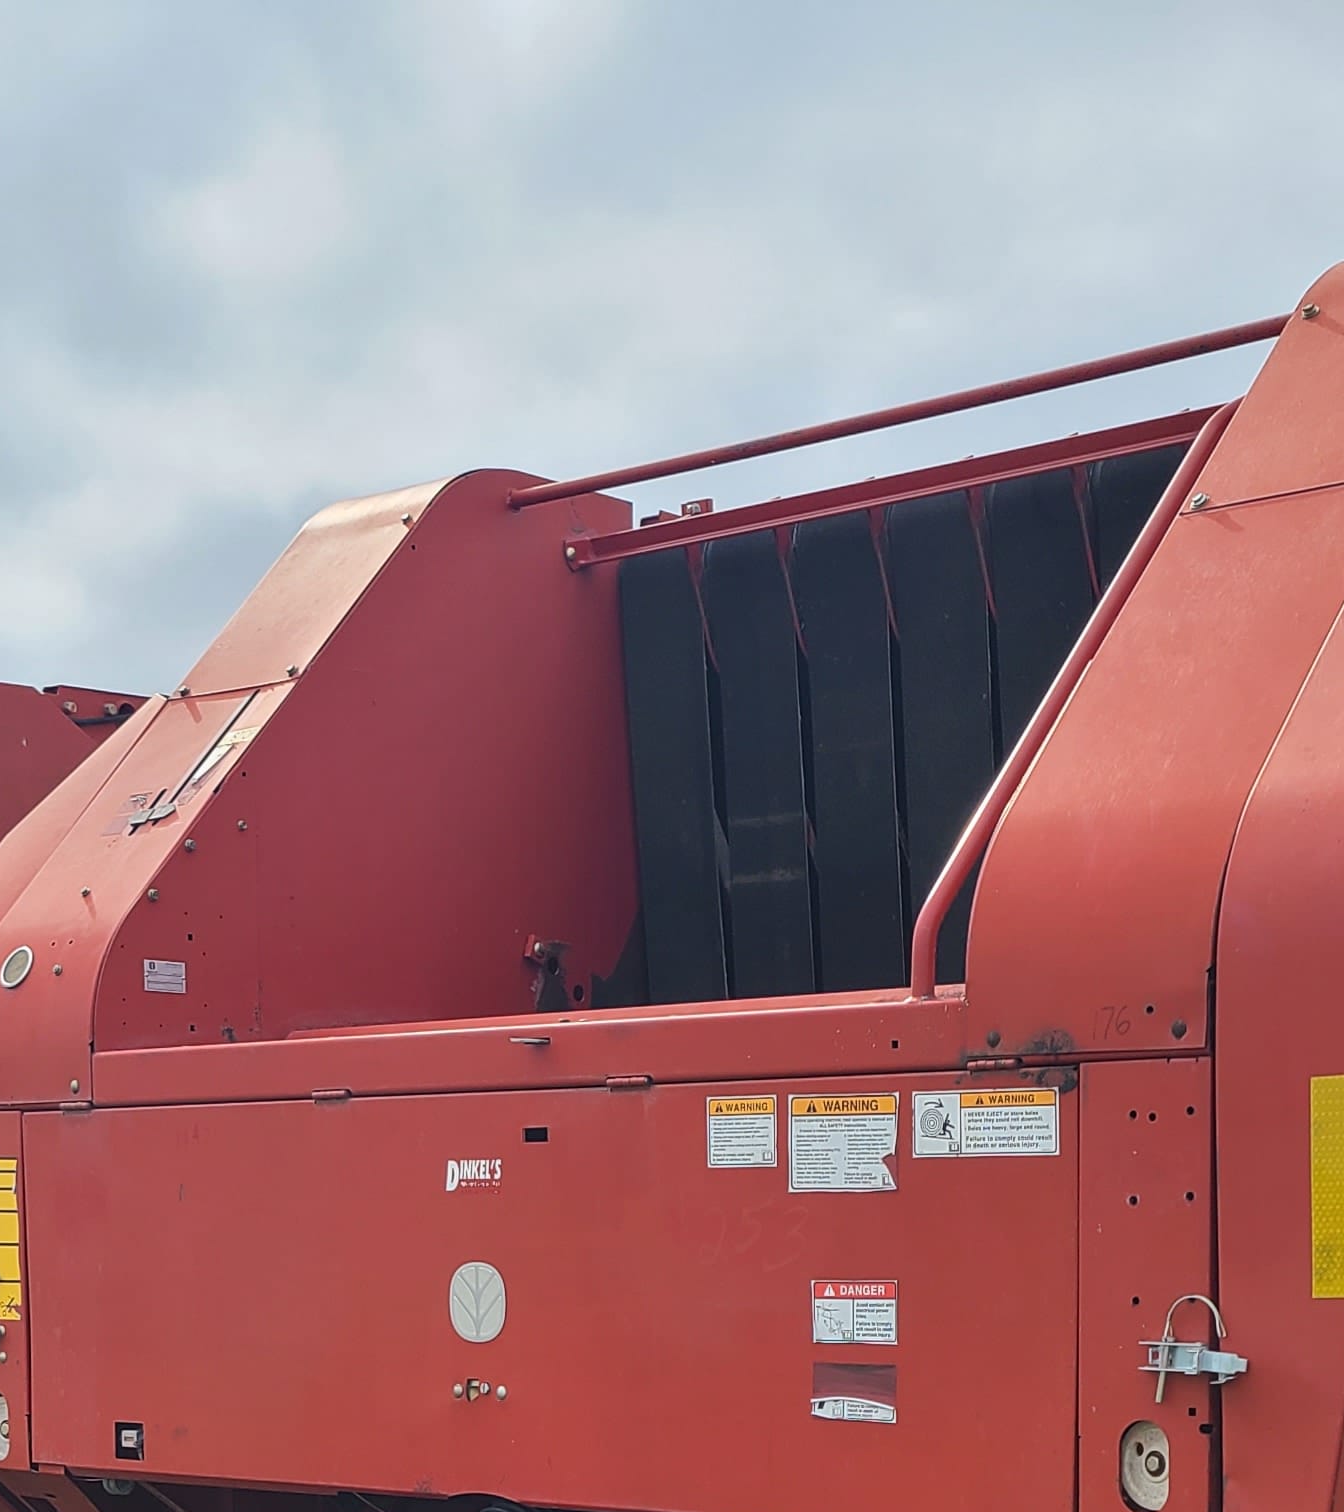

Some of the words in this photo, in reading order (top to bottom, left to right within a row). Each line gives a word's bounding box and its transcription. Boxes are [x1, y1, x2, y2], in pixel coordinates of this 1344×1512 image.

[988, 1094, 1035, 1104] WARNING
[725, 1102, 768, 1112] WARNING
[823, 1099, 879, 1112] WARNING
[445, 1158, 502, 1191] DINKEL'S
[839, 1285, 886, 1296] DANGER
